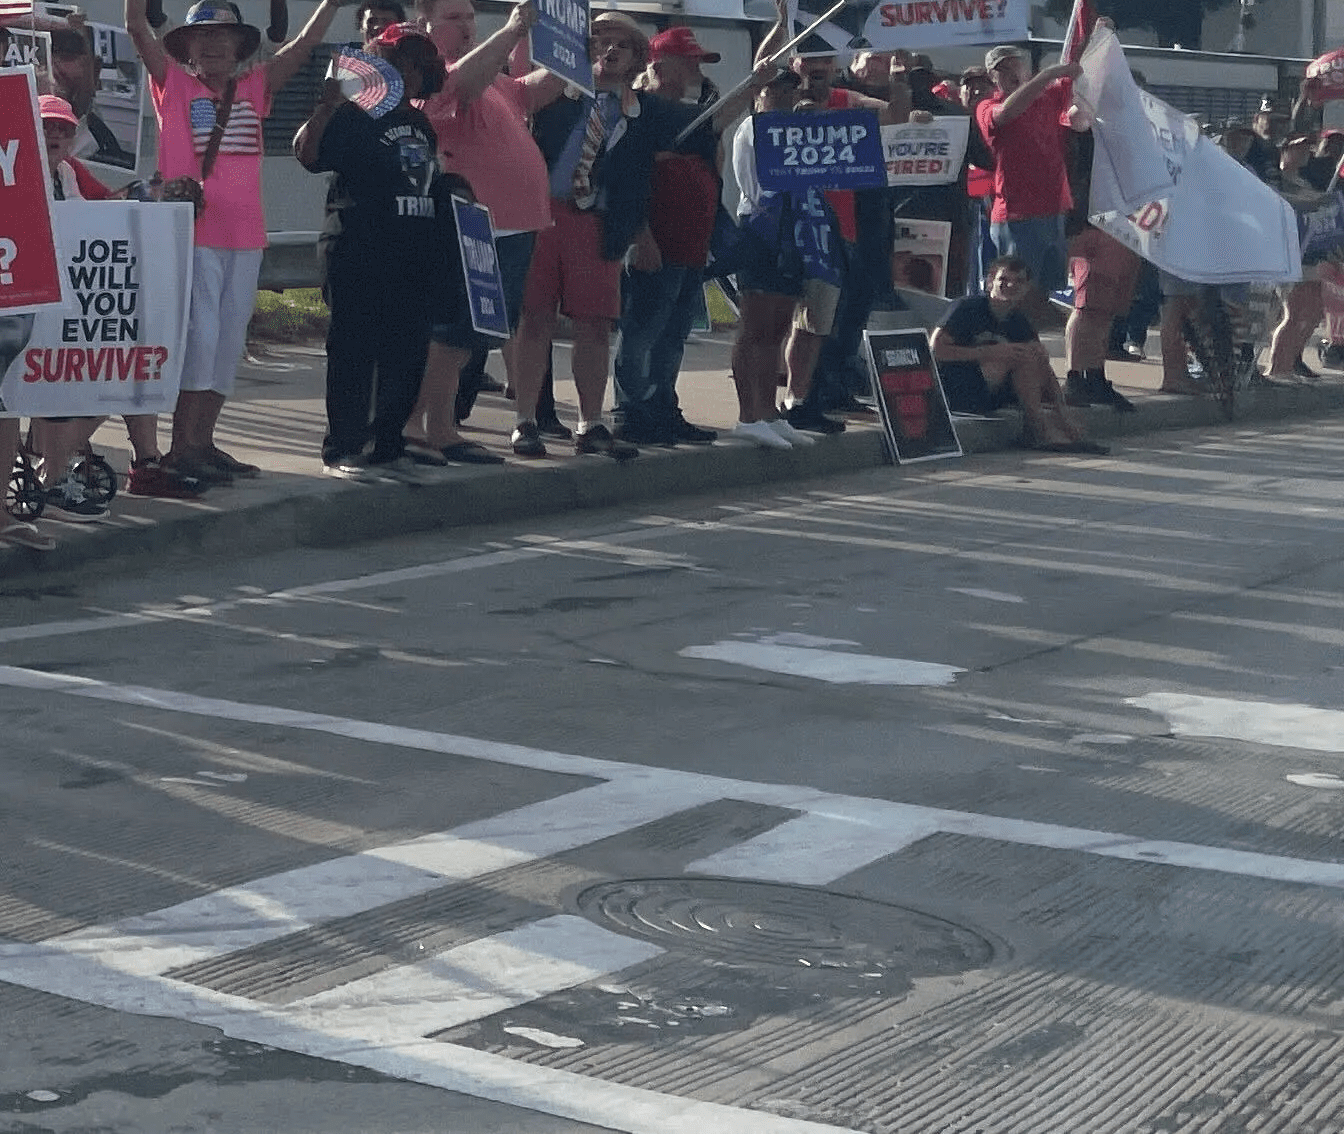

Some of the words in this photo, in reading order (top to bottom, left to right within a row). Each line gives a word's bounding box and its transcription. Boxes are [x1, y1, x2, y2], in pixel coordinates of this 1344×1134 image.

[767, 125, 867, 147] TRUMP
[783, 144, 856, 166] 2024
[887, 141, 951, 158] YOU'RE
[71, 239, 137, 267] JOE,
[68, 265, 140, 290] WILL
[76, 291, 137, 316] YOU
[61, 318, 139, 342] EVEN
[22, 345, 169, 383] SURVIVE?
